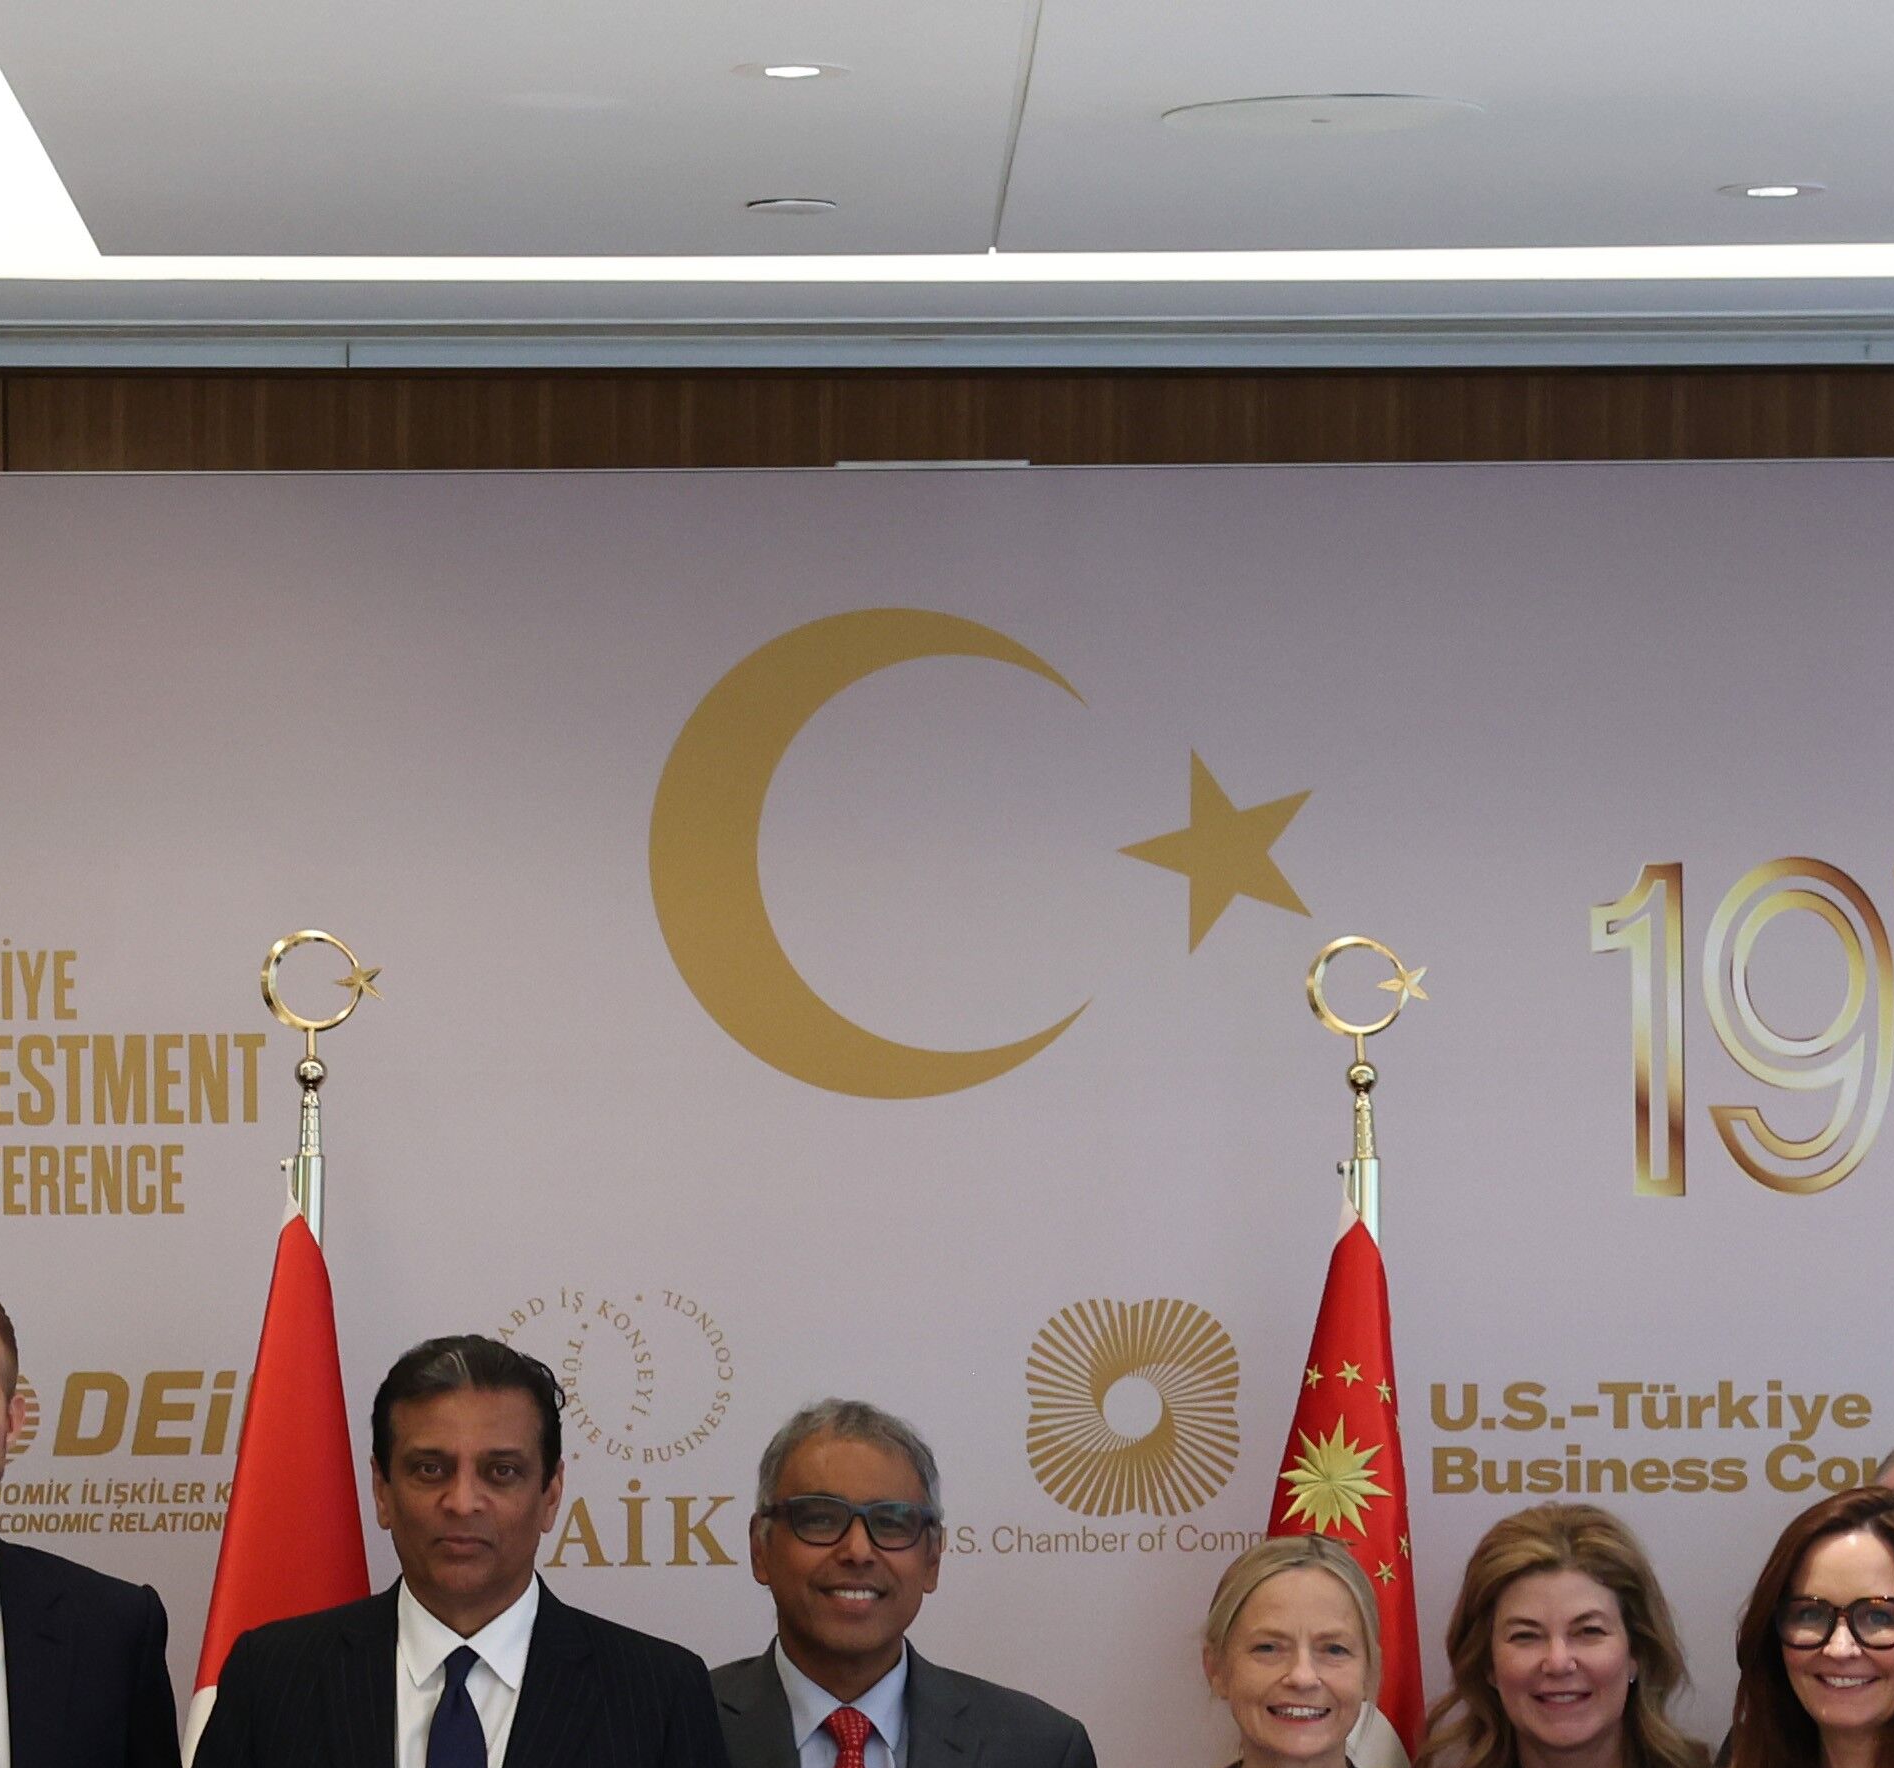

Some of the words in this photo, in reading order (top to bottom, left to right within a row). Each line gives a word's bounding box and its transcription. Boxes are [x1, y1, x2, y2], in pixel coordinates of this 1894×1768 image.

[498, 1297, 545, 1343] ABD
[663, 1291, 733, 1381] COUNCIL
[643, 1390, 732, 1464] BUSINESS
[1430, 1380, 1872, 1441] U.S.-Türkiye
[606, 1439, 633, 1461] US
[1432, 1444, 1748, 1494] Business
[81, 1477, 205, 1510] İLİŞKİLER
[109, 1512, 225, 1533] RELATION
[542, 1477, 739, 1567] AİK
[992, 1525, 1130, 1554] Chamber
[1137, 1524, 1166, 1553] of
